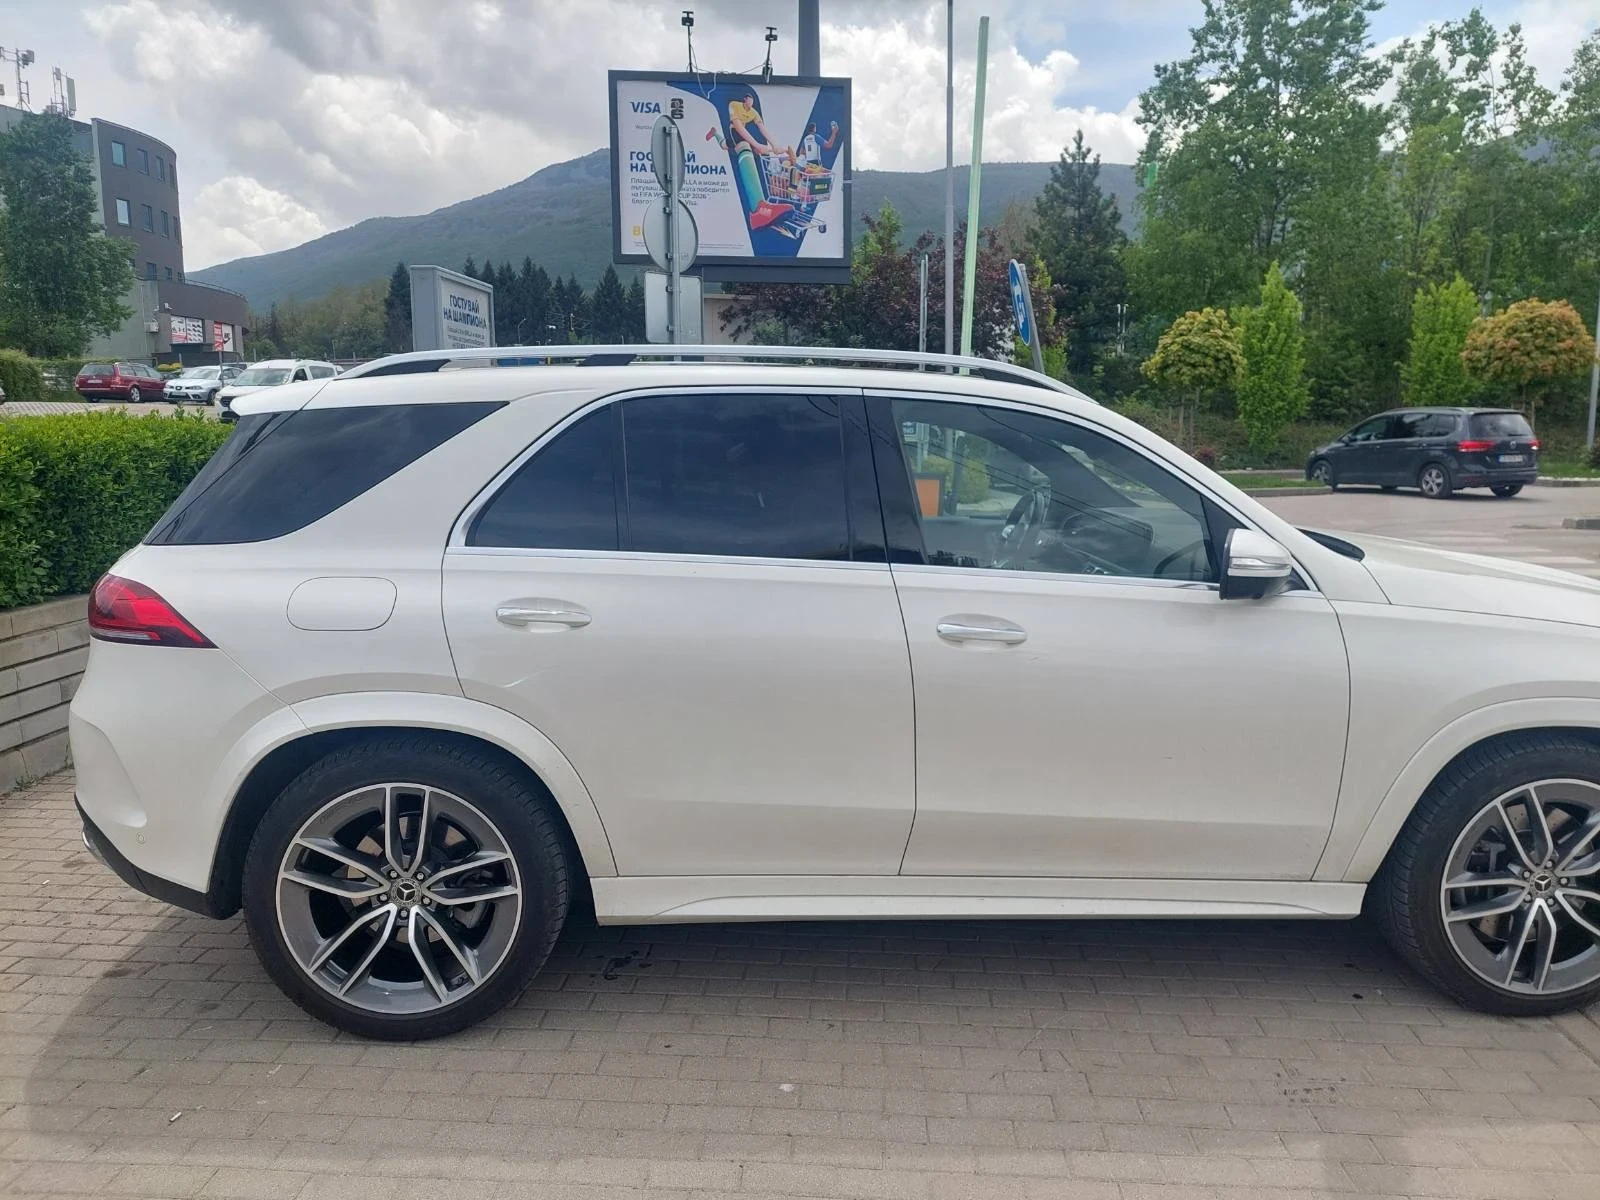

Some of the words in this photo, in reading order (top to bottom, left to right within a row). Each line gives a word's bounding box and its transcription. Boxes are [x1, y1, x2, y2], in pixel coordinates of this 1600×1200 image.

[630, 101, 662, 113] VISA
[630, 151, 696, 162] ГОСЙ
[630, 163, 647, 173] НА
[650, 164, 727, 175] ПИОНА
[449, 294, 480, 314] ГОСТУВАЙ
[443, 307, 453, 321] НА
[453, 309, 487, 329] ШАМПИОНА
